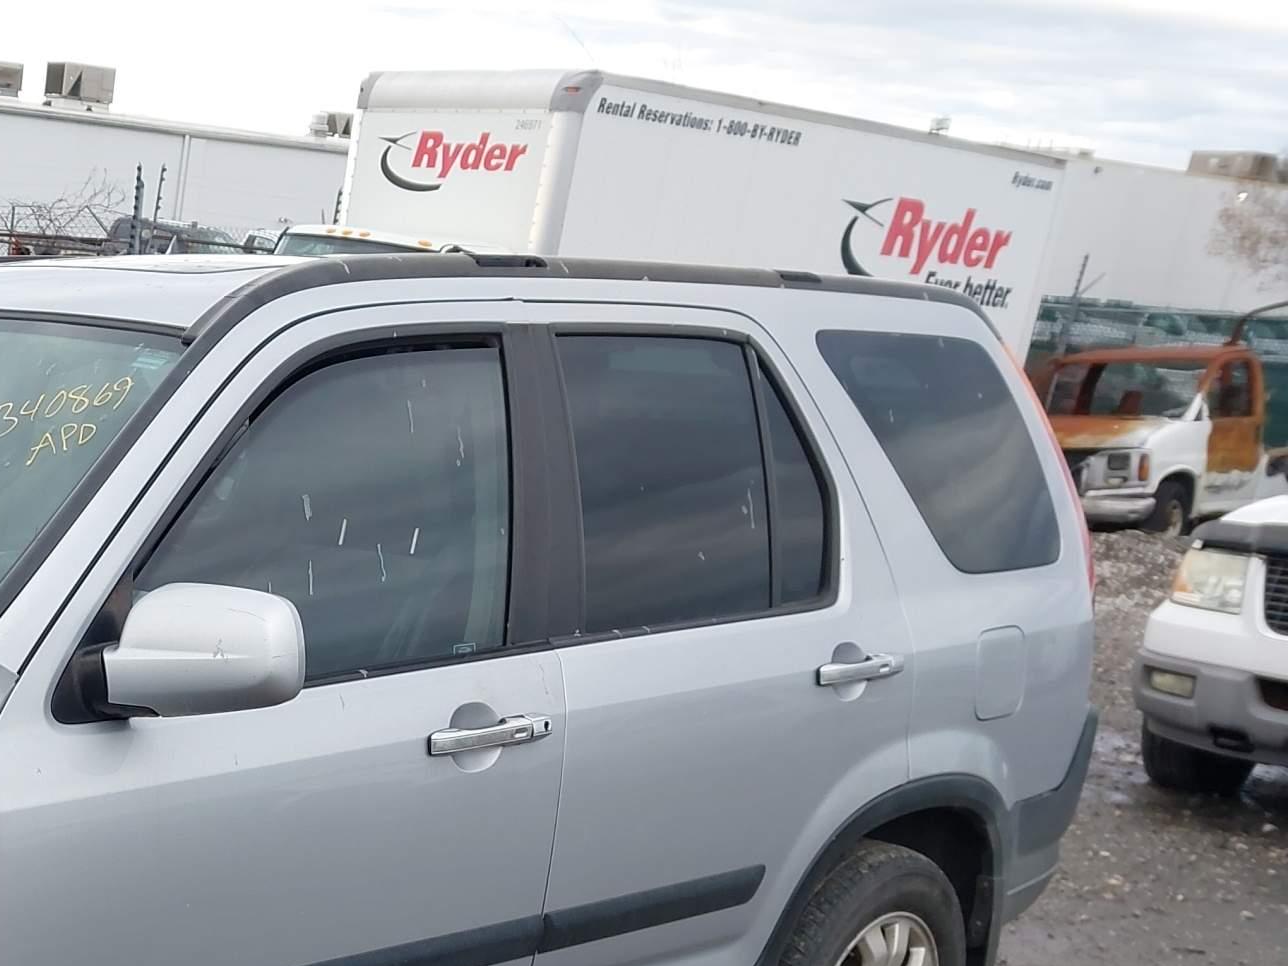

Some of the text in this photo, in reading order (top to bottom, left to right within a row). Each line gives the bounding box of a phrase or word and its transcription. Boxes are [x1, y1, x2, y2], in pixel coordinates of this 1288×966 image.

[596, 97, 803, 147] Rental Reservations: 1-800-BY-RYDER
[411, 130, 528, 179] Ryder
[880, 197, 1012, 275] Ryder
[25, 423, 97, 466] APD
